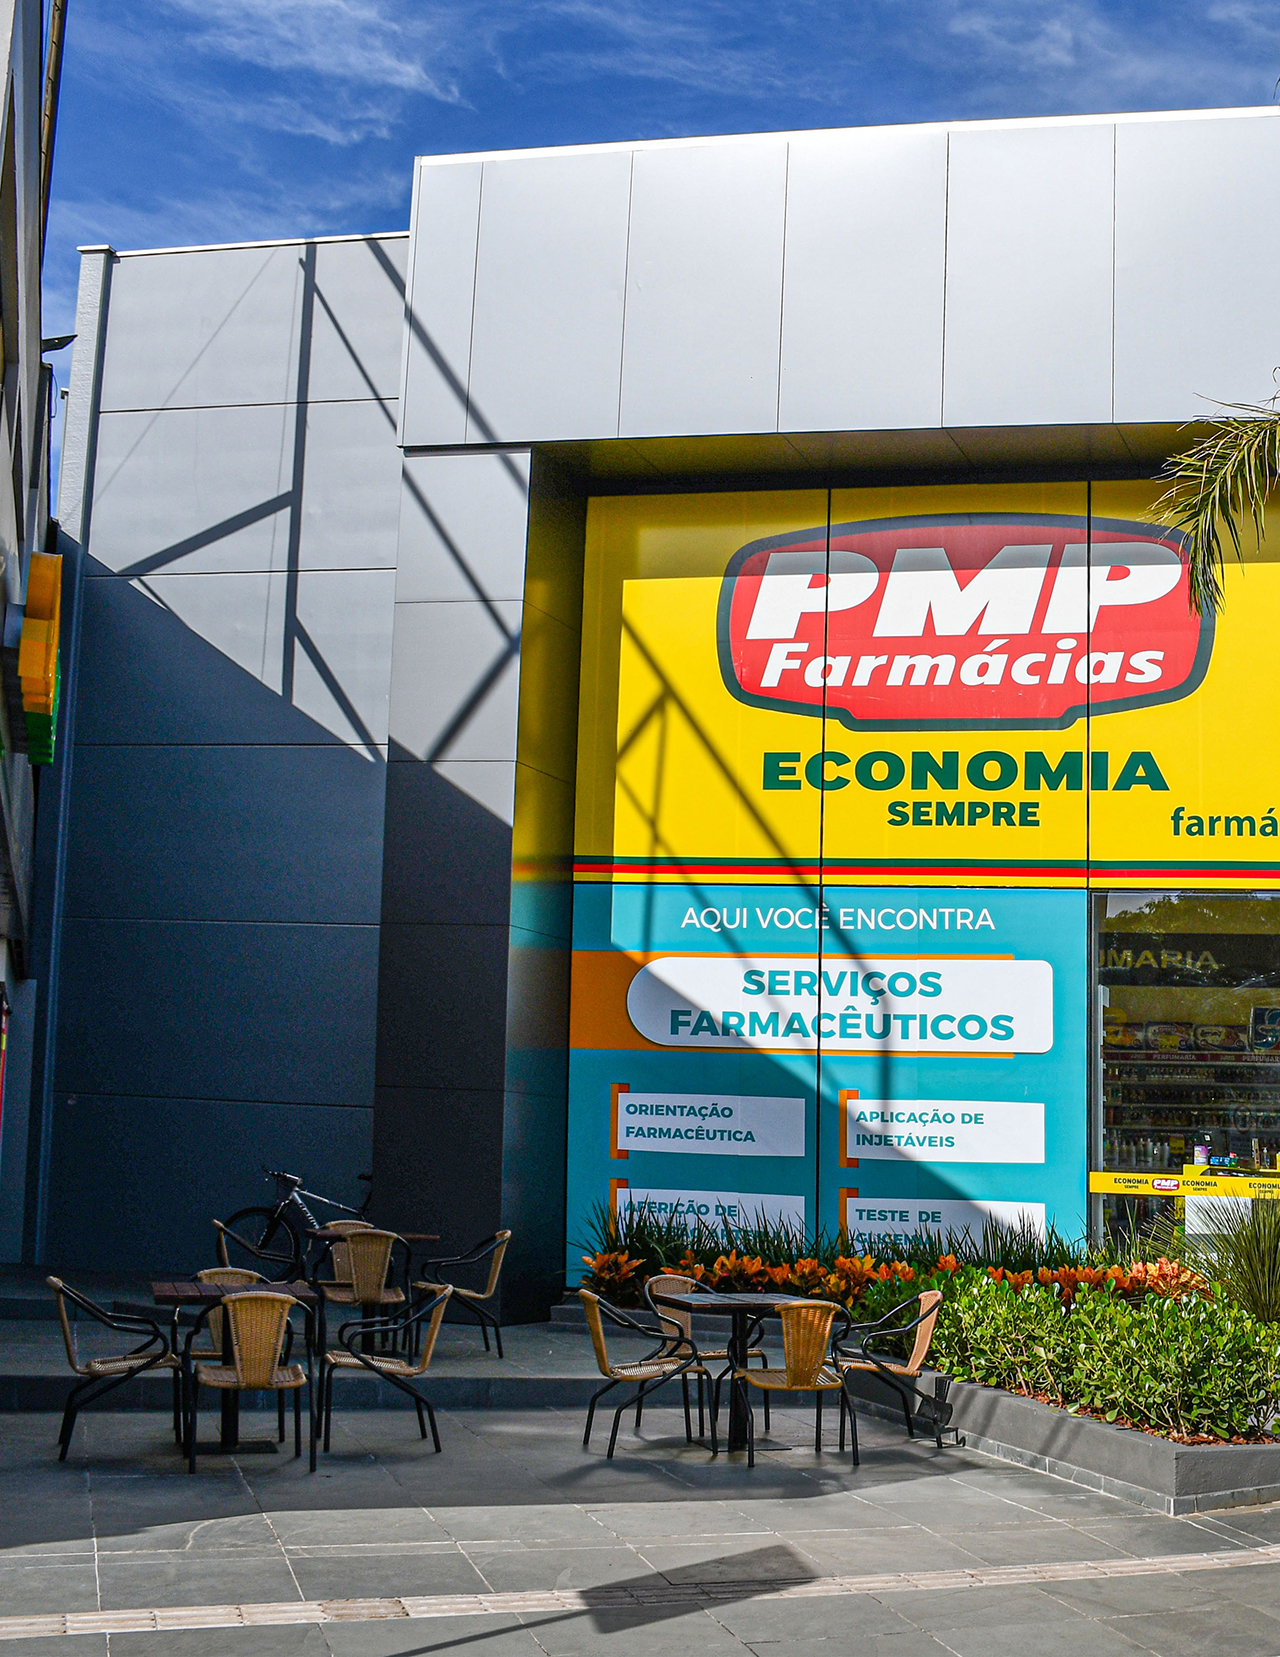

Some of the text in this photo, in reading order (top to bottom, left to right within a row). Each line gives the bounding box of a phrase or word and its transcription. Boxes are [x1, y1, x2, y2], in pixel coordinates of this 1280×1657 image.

[746, 542, 1183, 641] PMP
[759, 638, 1166, 689] Farmácias
[762, 750, 1171, 792] ECONOMIA
[886, 799, 1042, 828] SEMPRE
[681, 902, 996, 931] AQUI VOCÊ ENCONTRA
[742, 969, 943, 1006] SERVIÇOS
[670, 1005, 1016, 1042] FARMACÊUTICOS
[625, 1101, 734, 1121] ORIENTAÇÃO
[855, 1107, 985, 1128] APLICAÇÃO DE
[625, 1125, 756, 1143] FARMACÊUTICA
[855, 1130, 956, 1148] INJETÁVEIS
[1114, 1177, 1218, 1187] ECONOMIA PMP ECONOMIA
[714, 1204, 738, 1217] DE
[855, 1208, 942, 1223] TESTE DE
